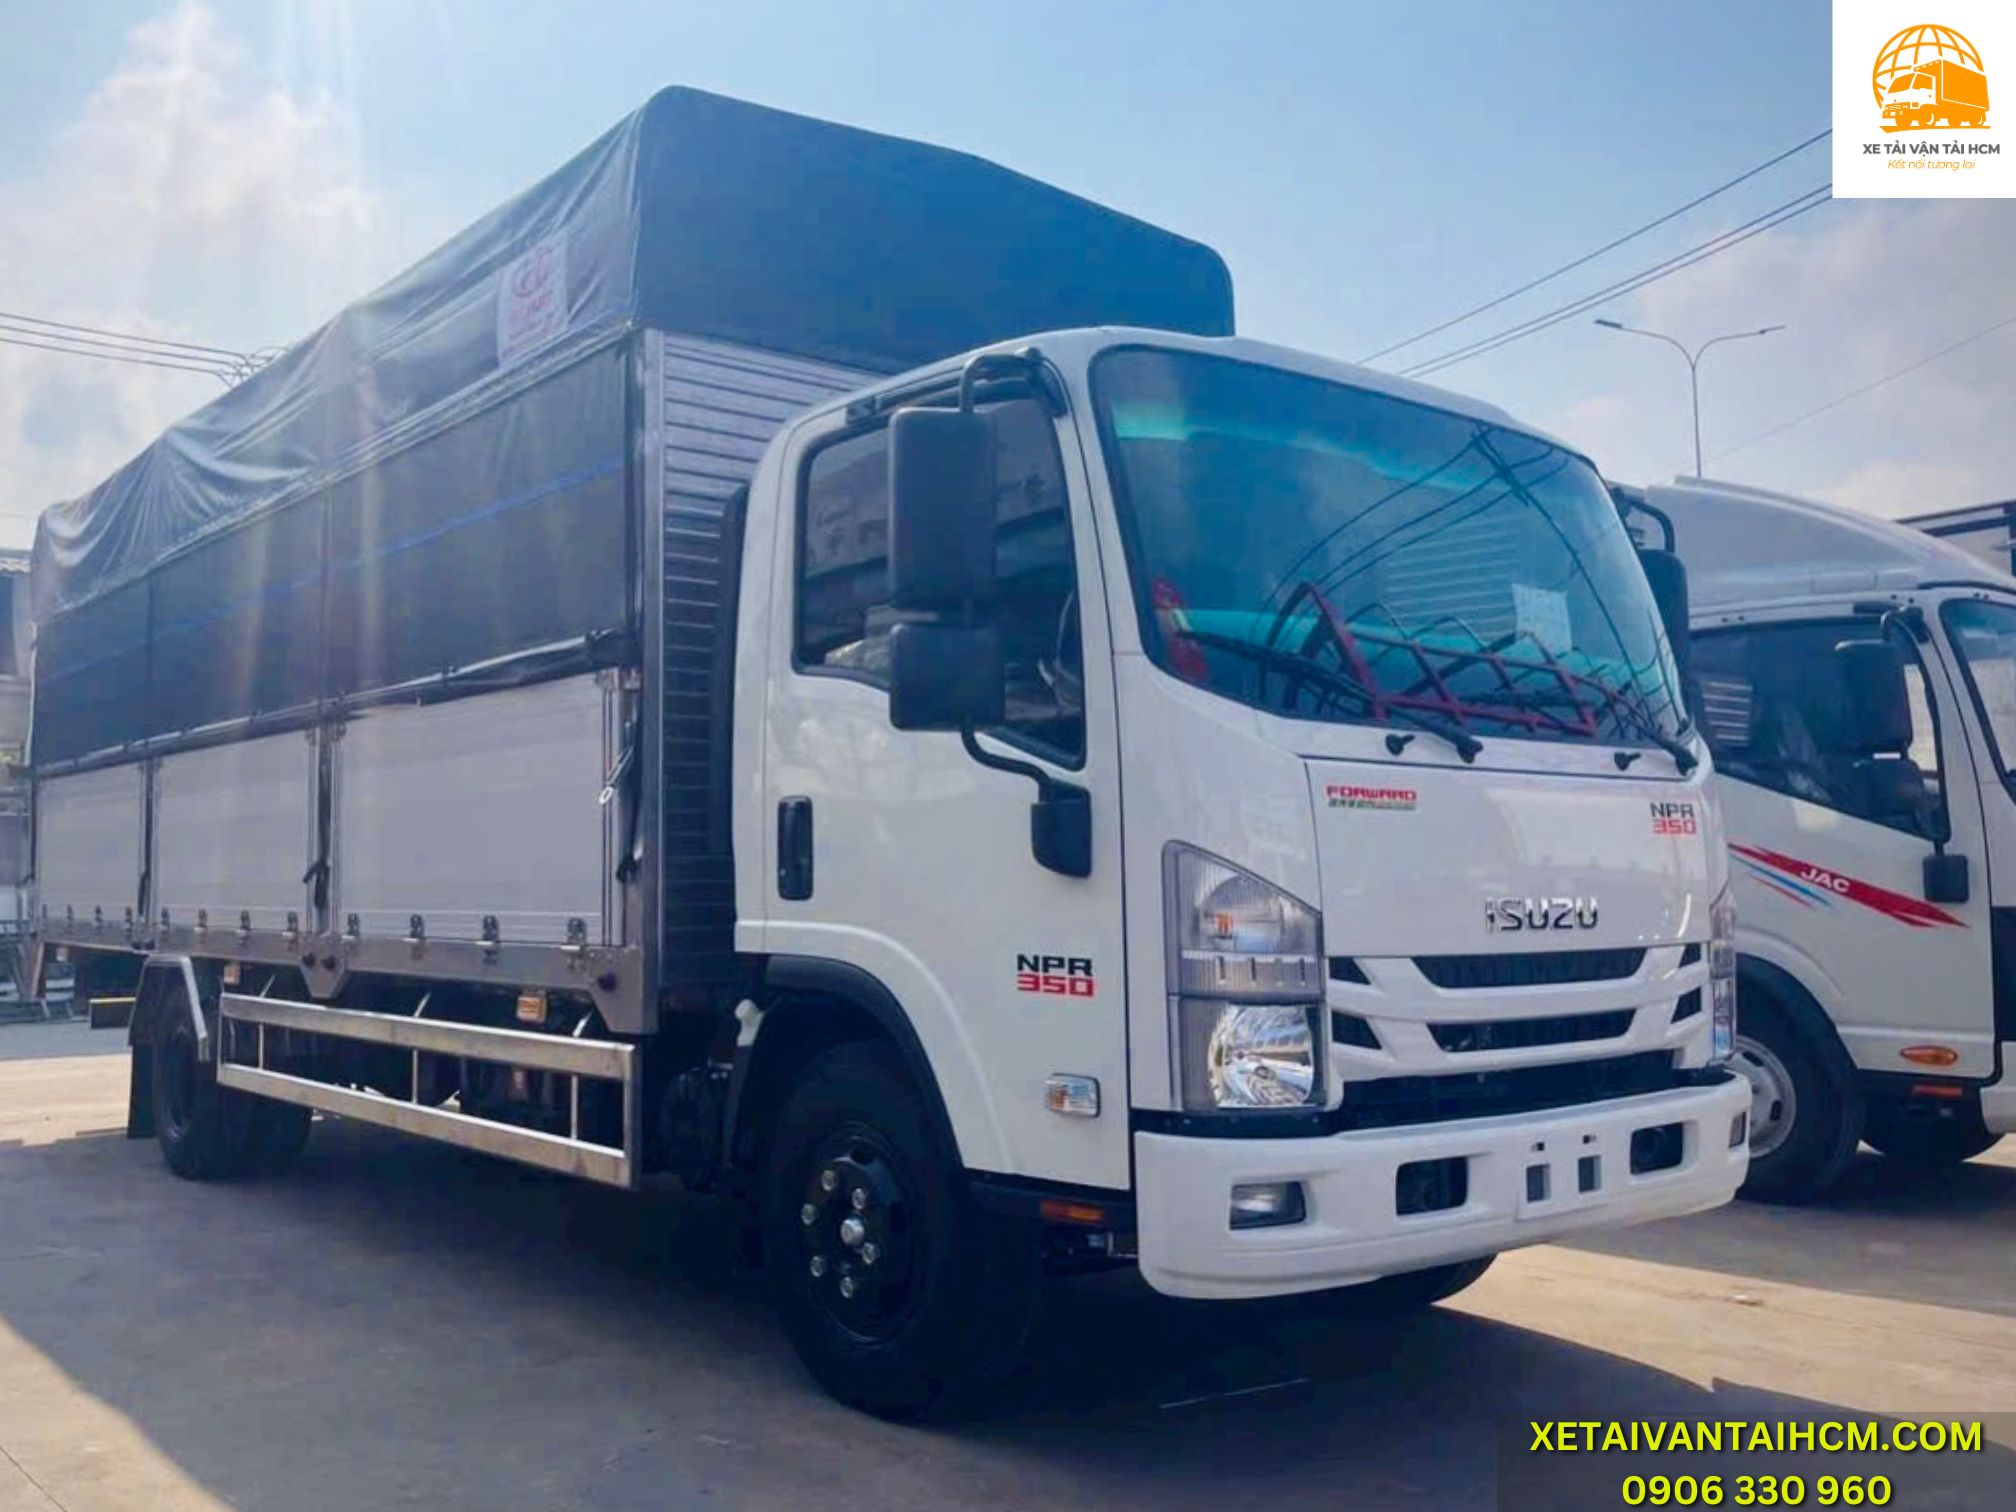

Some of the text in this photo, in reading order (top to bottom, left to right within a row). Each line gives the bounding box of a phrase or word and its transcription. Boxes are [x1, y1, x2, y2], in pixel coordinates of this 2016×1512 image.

[1651, 802, 1694, 818] NPR
[1653, 819, 1697, 834] 350
[1801, 868, 1851, 893] JAC
[1486, 897, 1599, 932] ISUZU
[1017, 954, 1093, 977] NPR
[1017, 973, 1095, 997] 350
